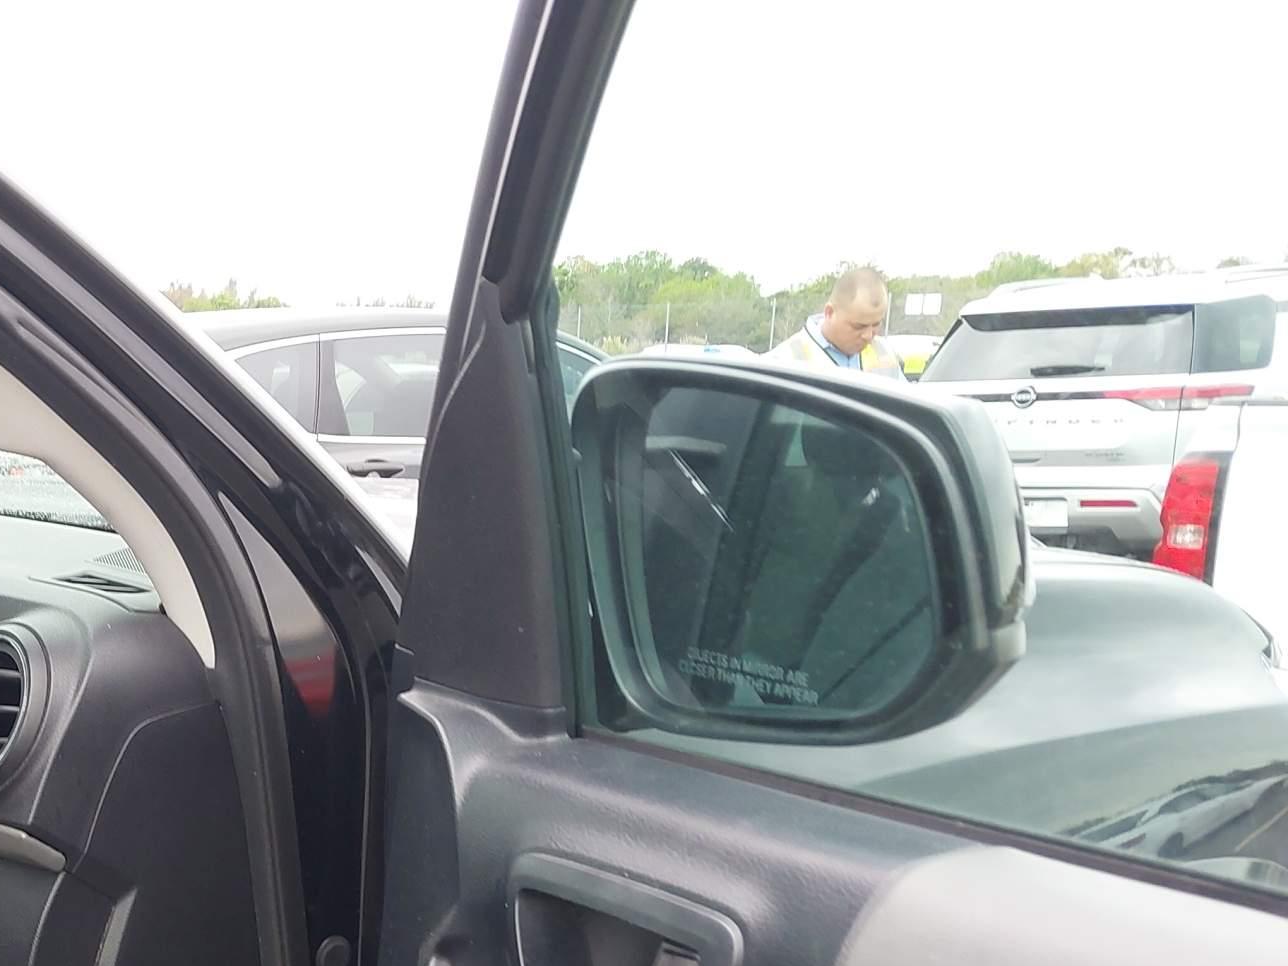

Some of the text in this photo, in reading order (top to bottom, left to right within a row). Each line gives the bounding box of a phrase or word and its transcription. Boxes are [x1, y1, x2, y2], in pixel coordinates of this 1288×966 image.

[679, 659, 715, 679] CLOSER
[773, 683, 819, 706] APPEAR
[687, 647, 728, 667] OBJECTS
[729, 656, 742, 670] IN
[786, 669, 810, 687] ARE
